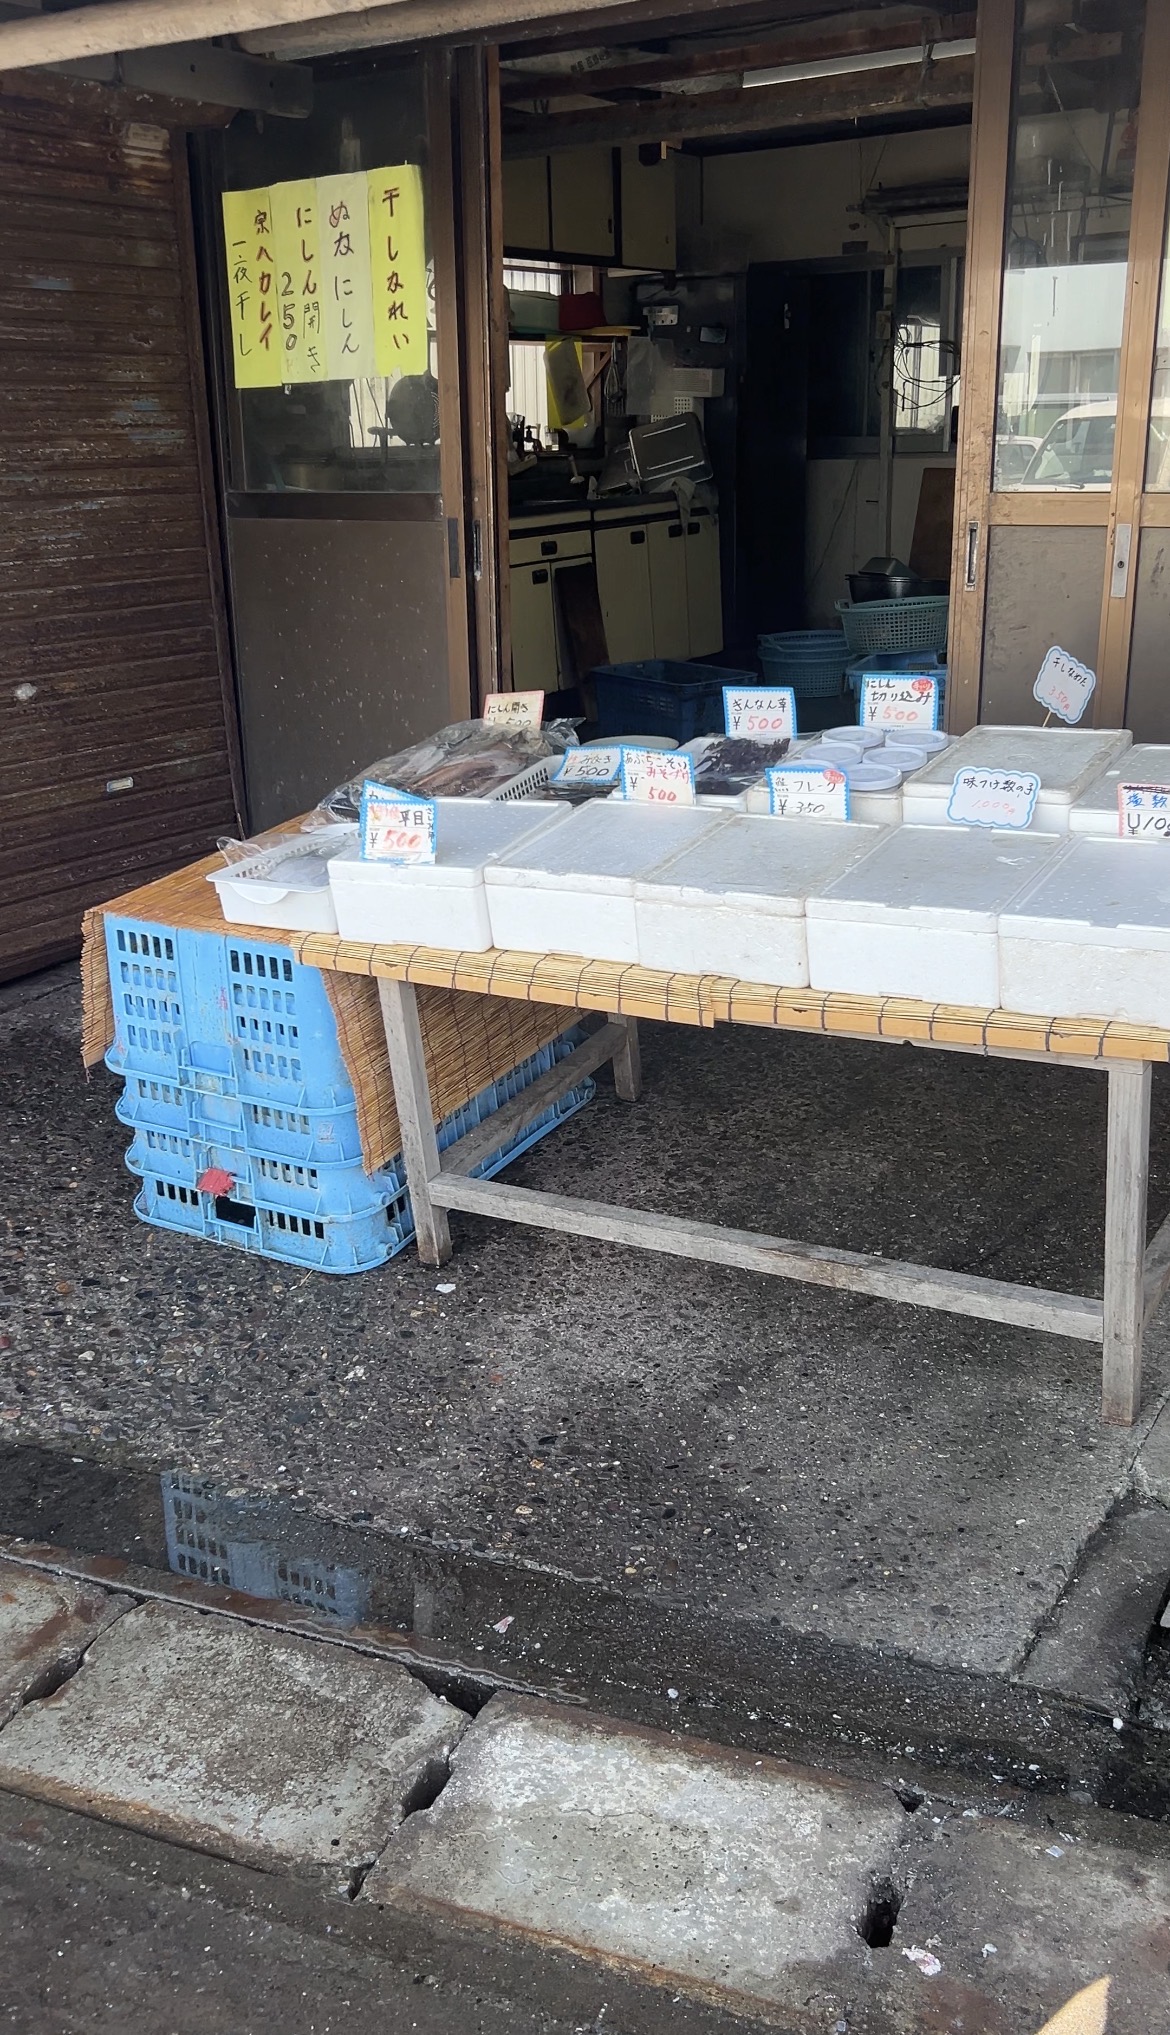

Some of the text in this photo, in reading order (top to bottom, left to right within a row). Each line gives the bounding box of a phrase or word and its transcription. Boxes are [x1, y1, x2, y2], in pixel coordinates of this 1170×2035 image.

[232, 240, 253, 357] 一夜干し
[281, 271, 297, 351] 250
[733, 697, 787, 713] ぎんなん草
[871, 690, 933, 705] 切り込み
[399, 809, 424, 827] 平目
